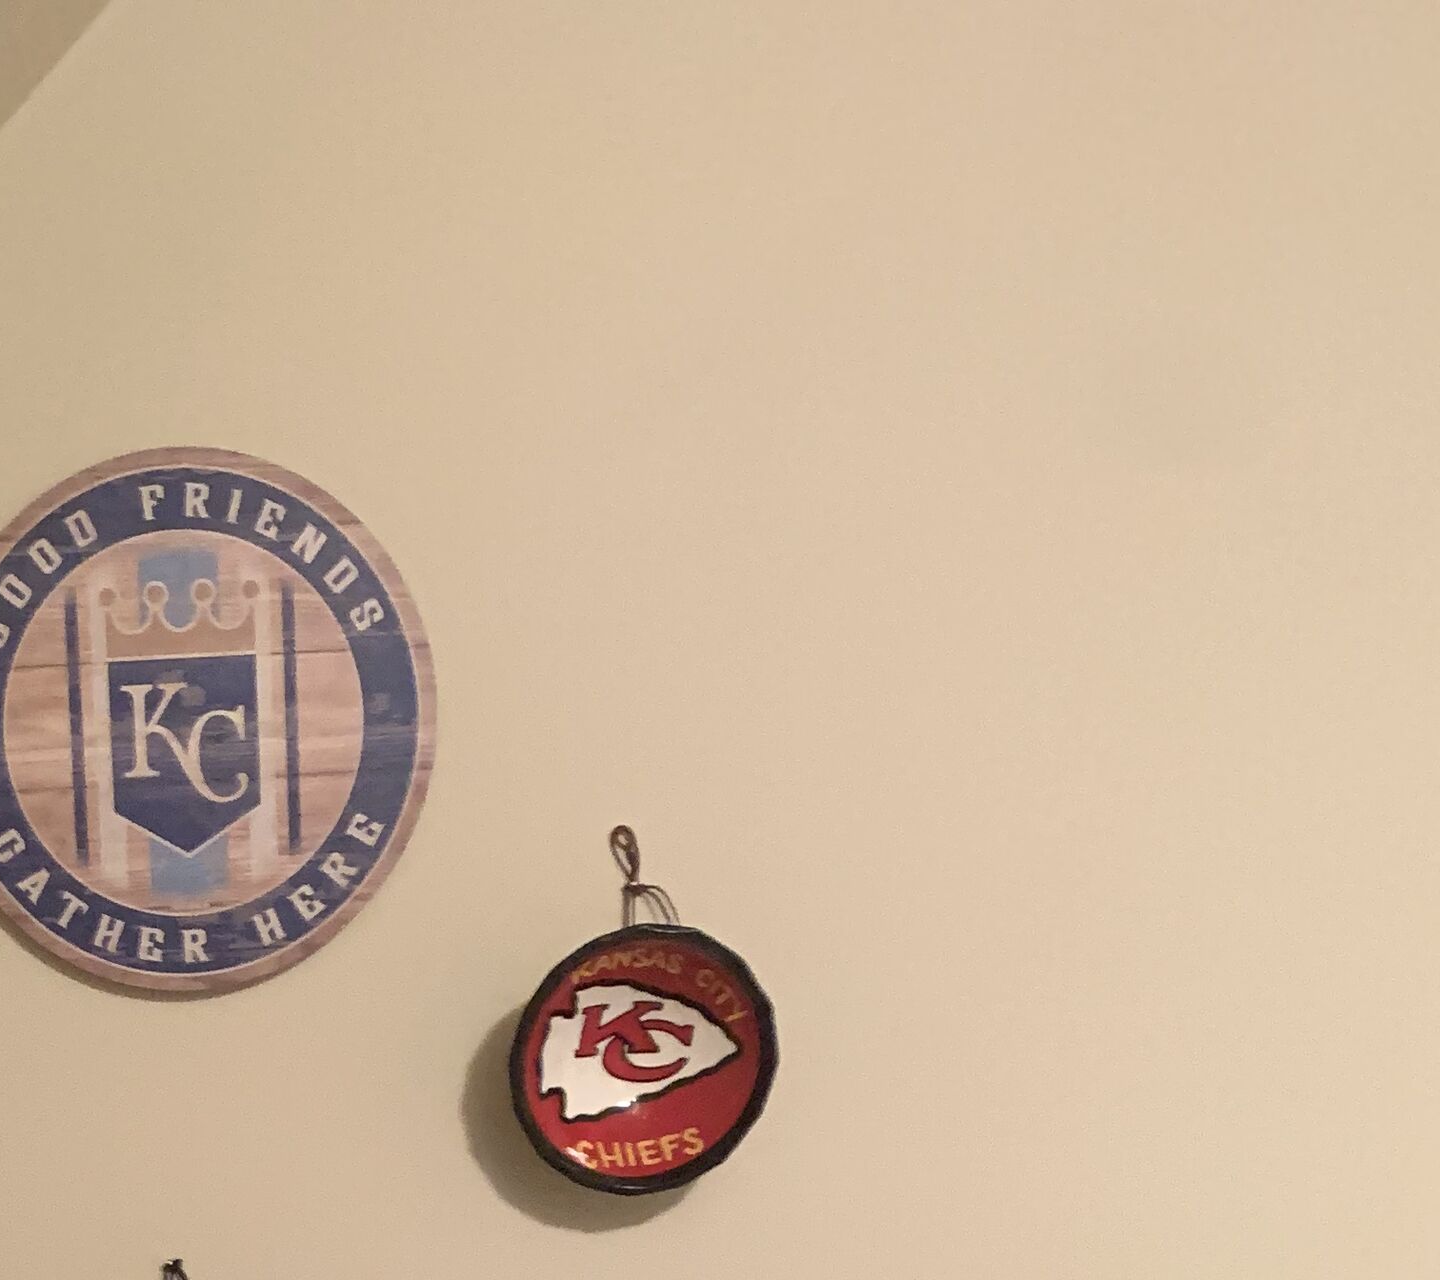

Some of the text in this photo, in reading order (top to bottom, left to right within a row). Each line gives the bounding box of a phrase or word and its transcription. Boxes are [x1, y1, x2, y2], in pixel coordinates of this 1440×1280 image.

[138, 481, 385, 632] FRIENDS
[119, 680, 249, 803] KC
[251, 812, 386, 948] HERE
[571, 948, 749, 1023] KANSAS CITY
[574, 1000, 695, 1082] KC
[568, 1127, 704, 1168] CHIEFS
